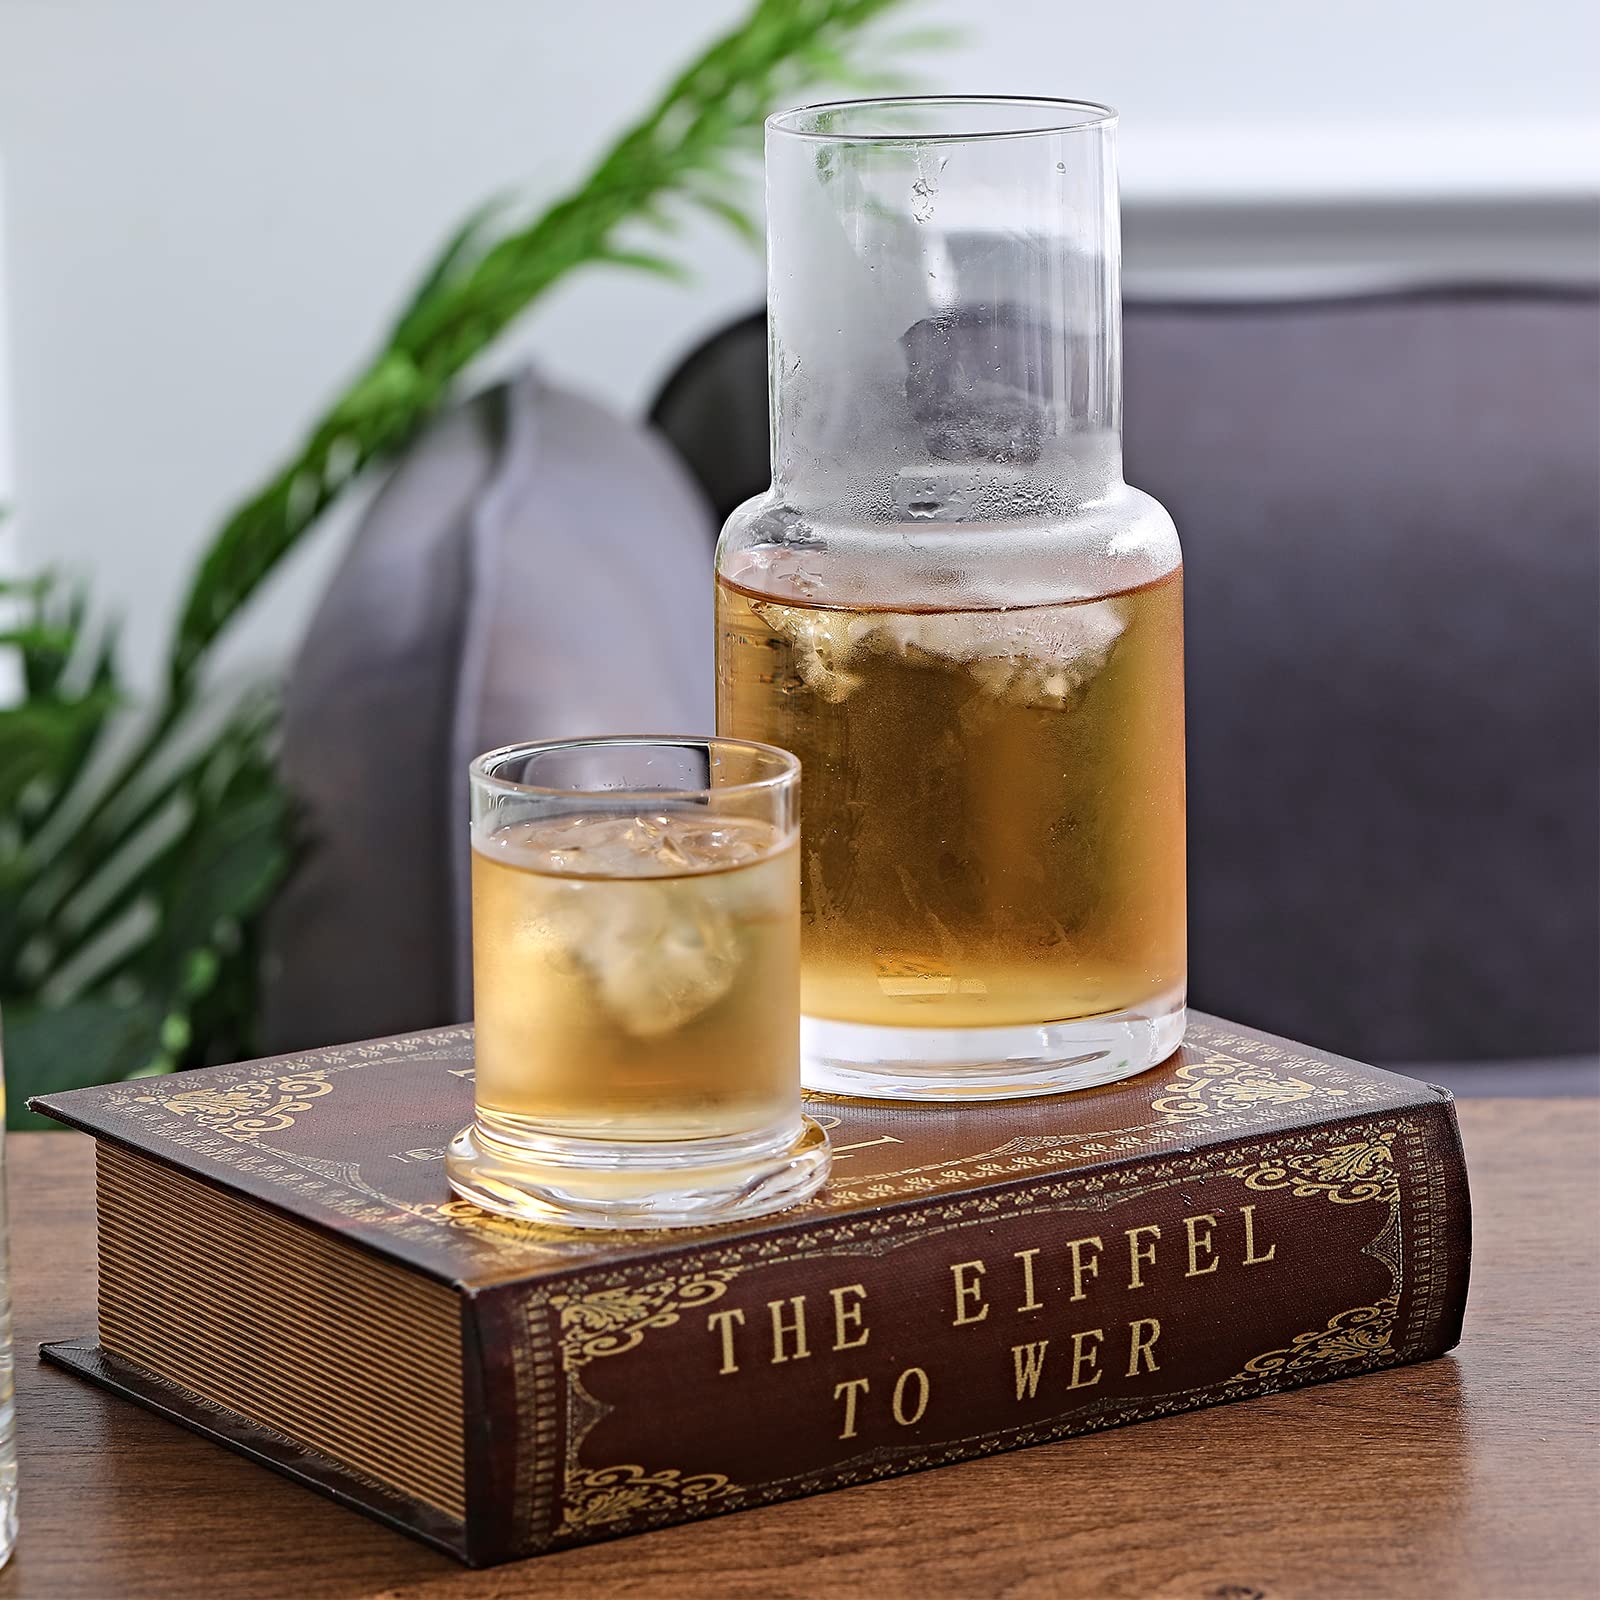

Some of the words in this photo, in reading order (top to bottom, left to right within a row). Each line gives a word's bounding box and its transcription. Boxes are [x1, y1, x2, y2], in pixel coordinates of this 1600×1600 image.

[707, 1283, 870, 1376] THE
[949, 1204, 1277, 1327] EIFFEL
[833, 1367, 930, 1440] TO
[1011, 1318, 1163, 1402] WER
